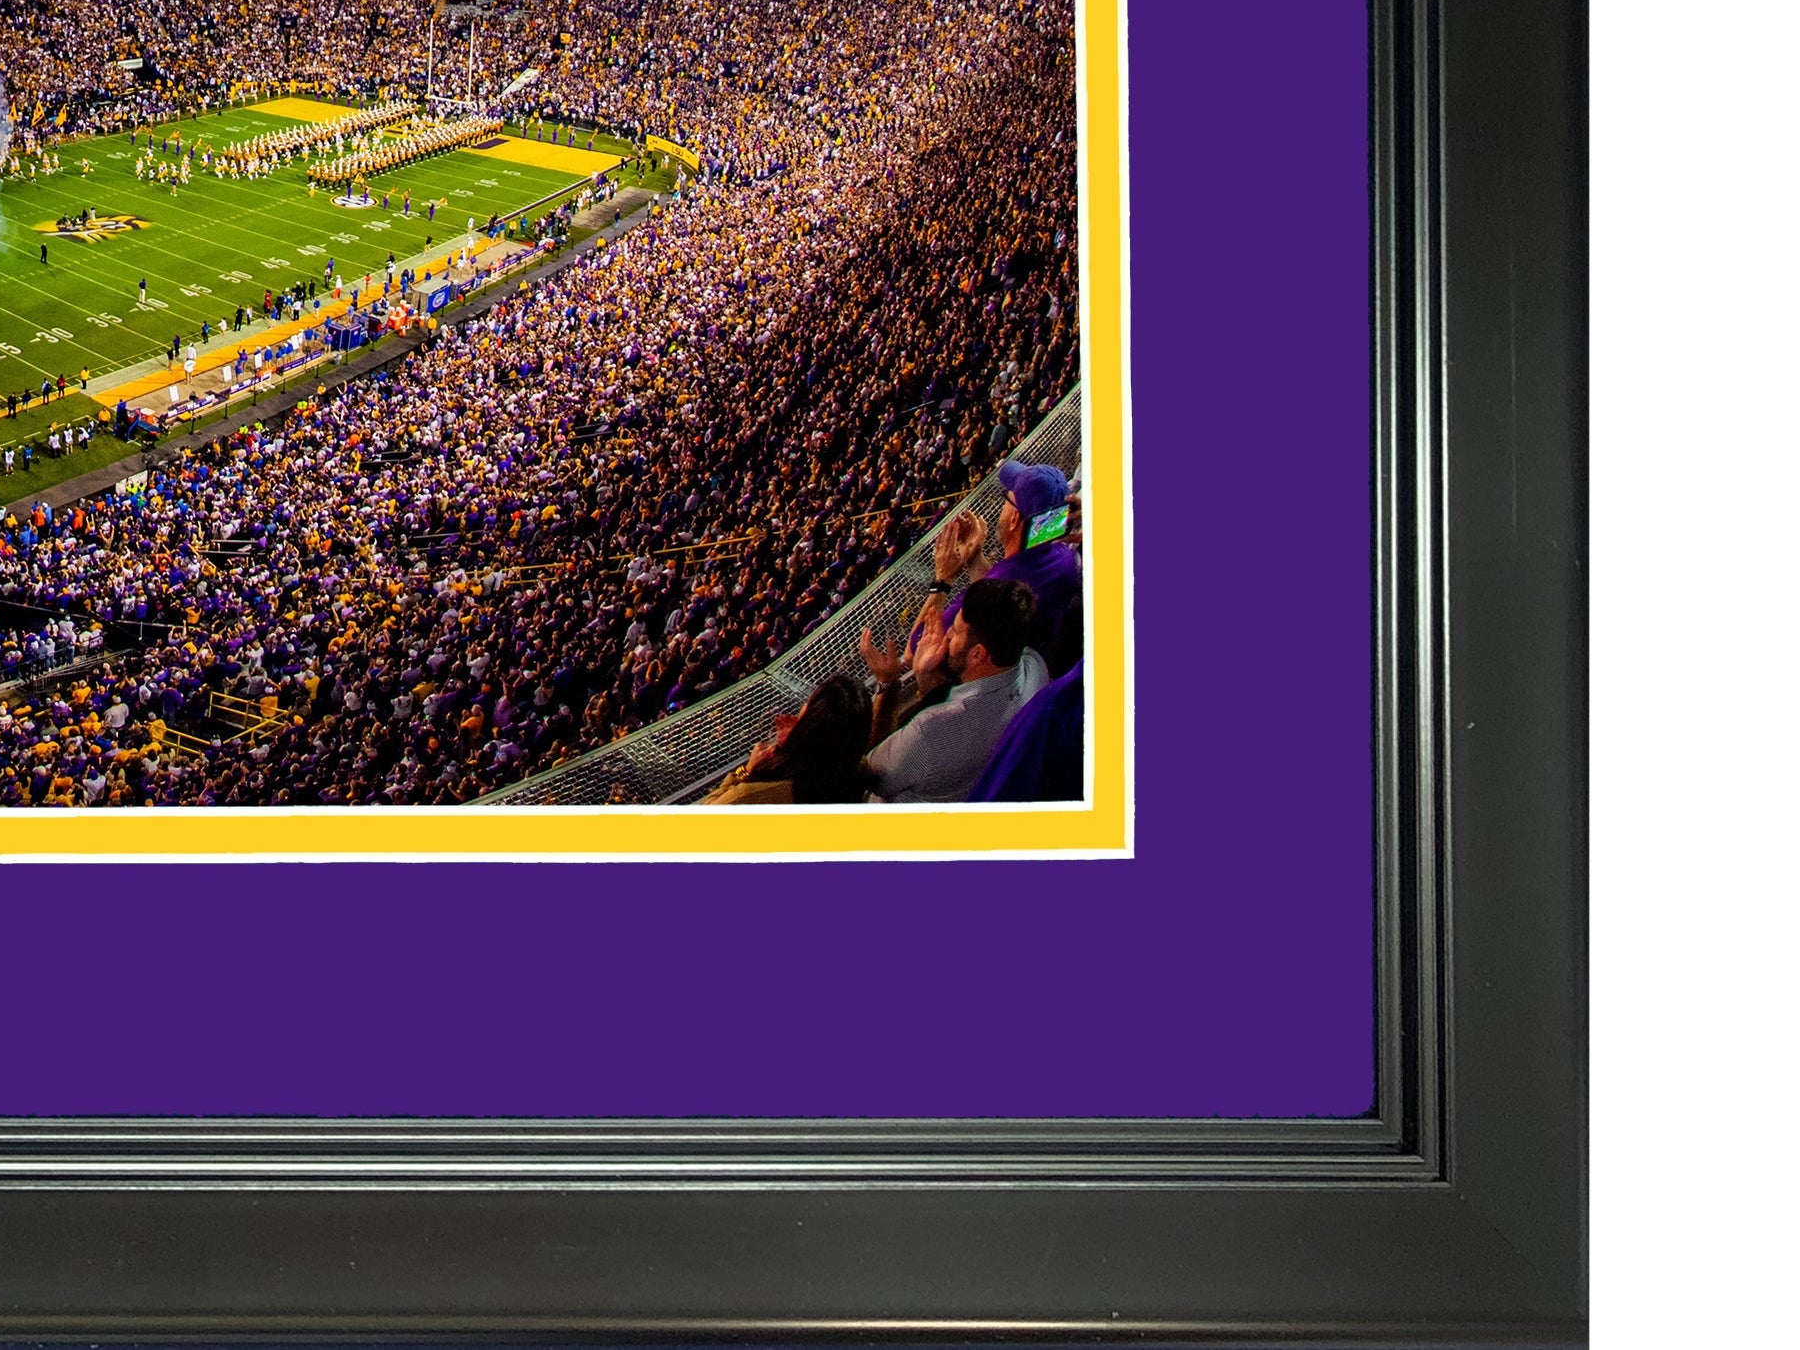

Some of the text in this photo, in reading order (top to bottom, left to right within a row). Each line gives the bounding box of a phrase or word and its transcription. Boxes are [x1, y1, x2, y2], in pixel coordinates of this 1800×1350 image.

[296, 245, 327, 256] 40
[260, 257, 291, 270] 45
[218, 270, 253, 284] 50
[179, 283, 213, 297] 45
[135, 298, 169, 312] 40
[86, 312, 123, 328] 35
[36, 327, 74, 343] 30
